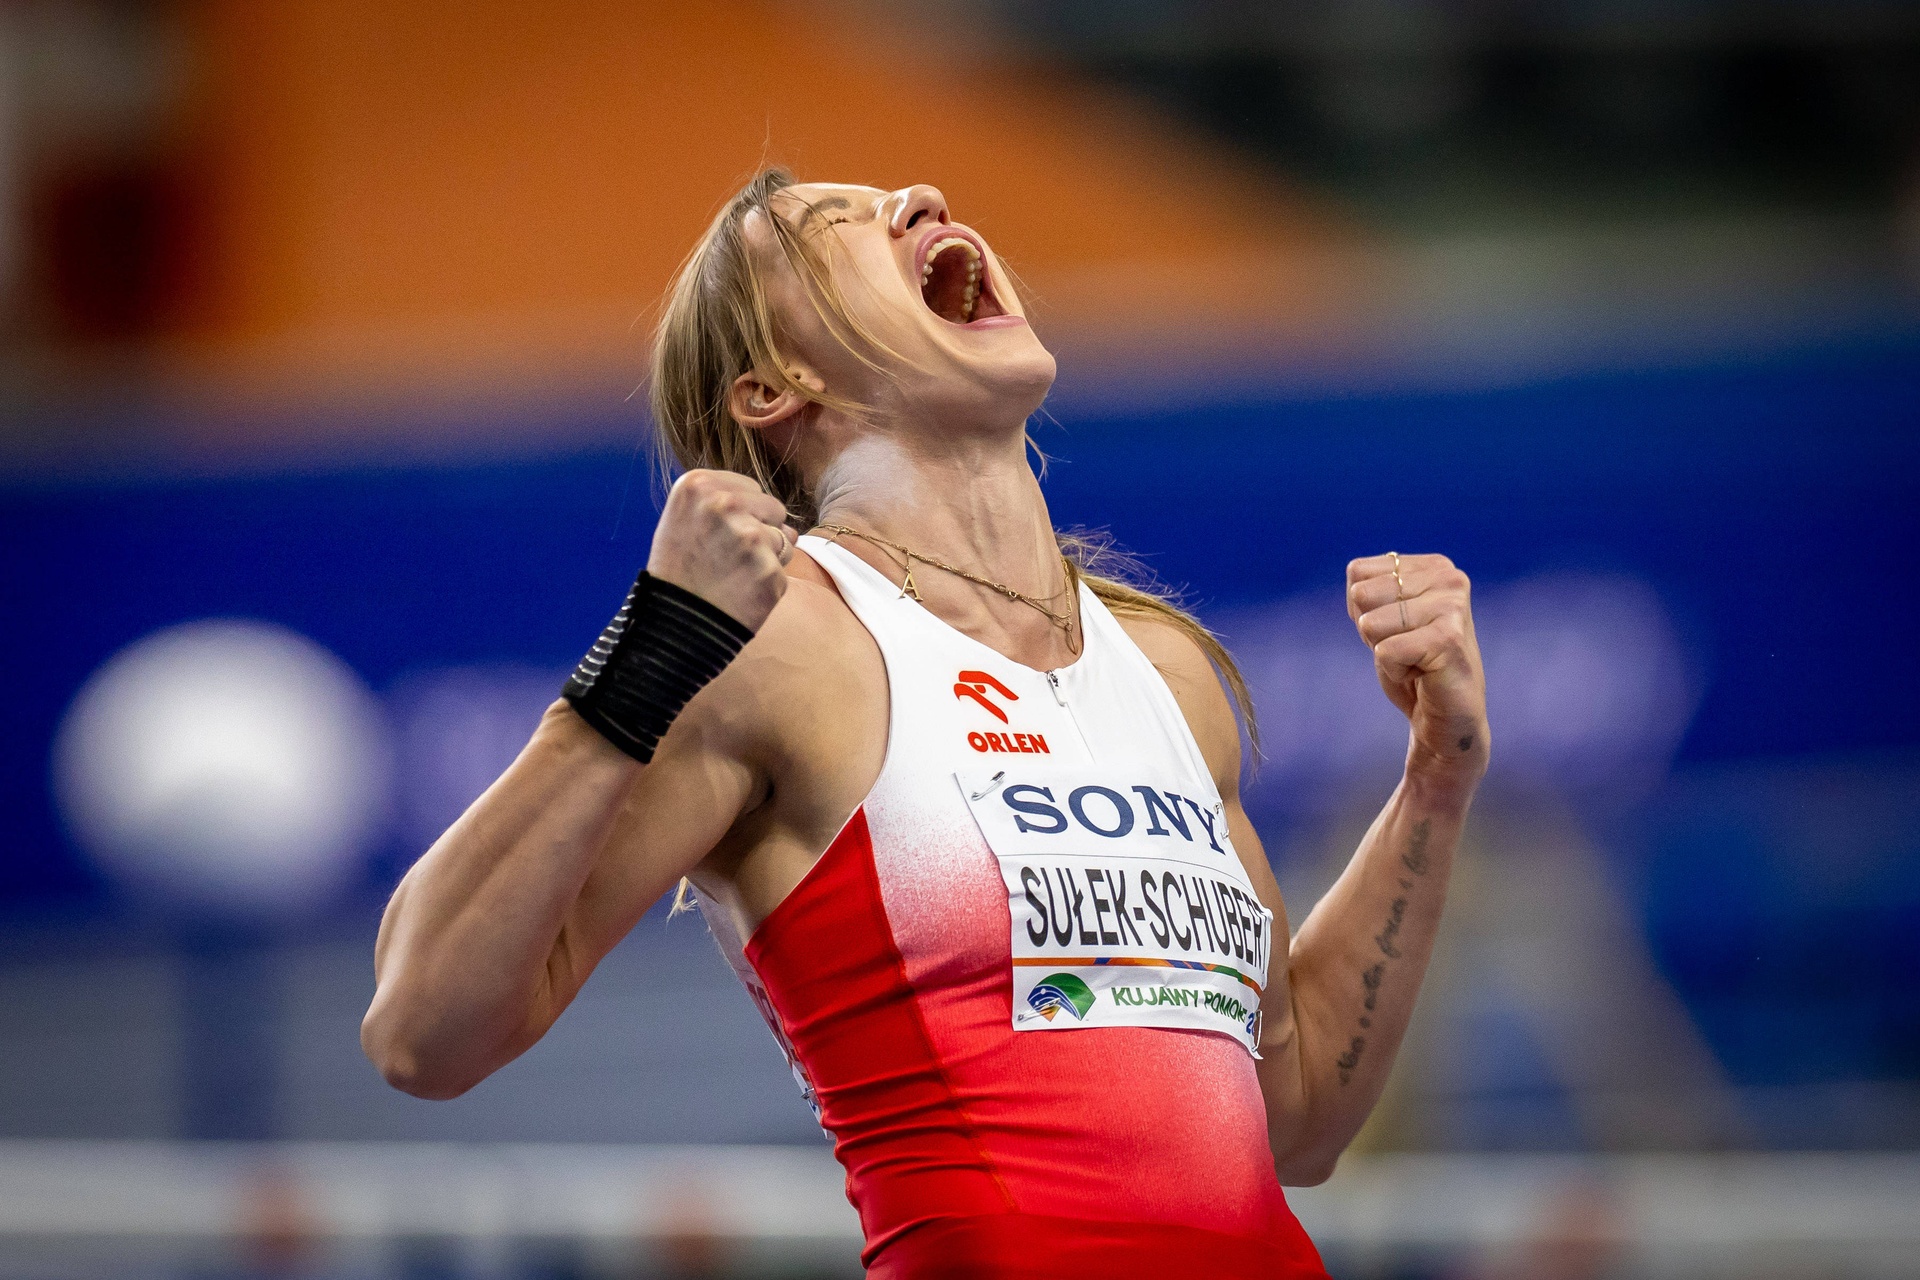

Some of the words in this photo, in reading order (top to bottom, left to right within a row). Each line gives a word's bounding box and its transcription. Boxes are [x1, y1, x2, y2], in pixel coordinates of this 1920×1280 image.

[967, 731, 1051, 754] ORLEN
[1002, 784, 1226, 855] SONY
[1111, 987, 1199, 1007] KUJAWY
